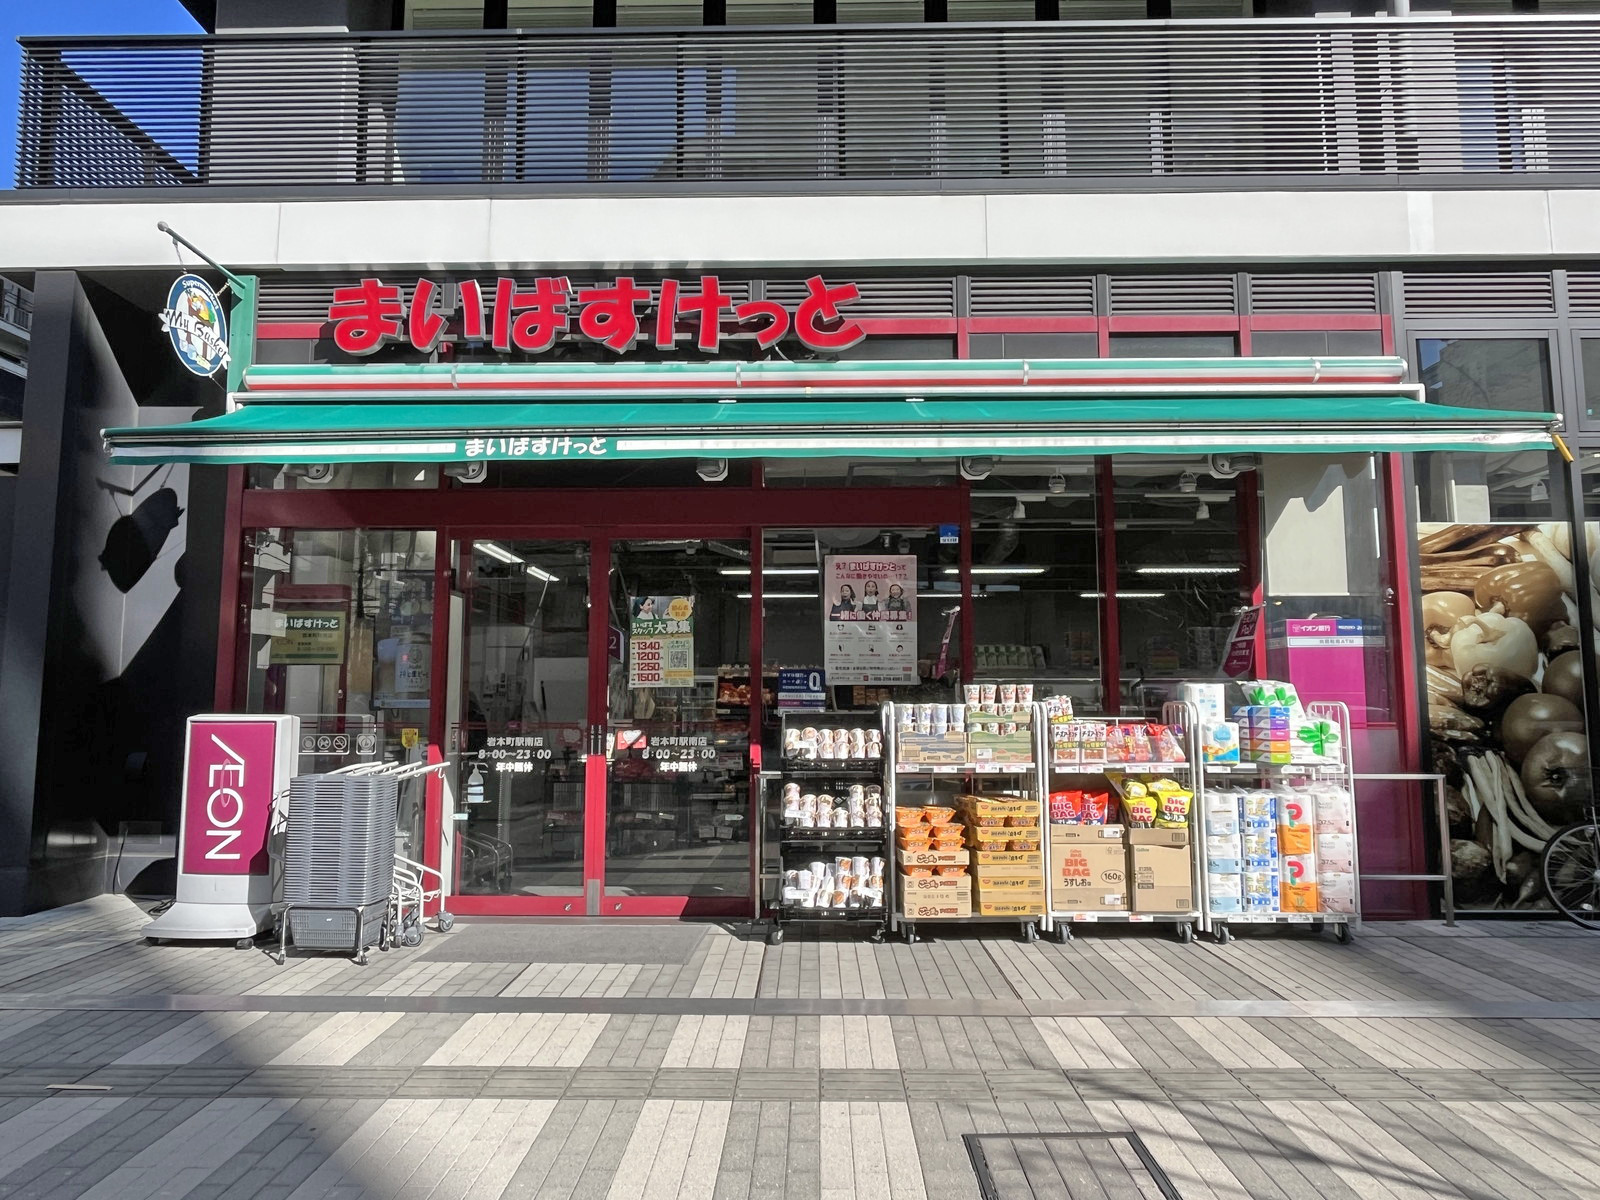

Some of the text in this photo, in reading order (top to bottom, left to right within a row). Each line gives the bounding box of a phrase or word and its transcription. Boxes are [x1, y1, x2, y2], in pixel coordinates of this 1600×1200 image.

[181, 280, 220, 310] Supermarket
[328, 275, 867, 356] まいばすけっと
[165, 310, 228, 358] My Basket
[464, 436, 608, 457] まいばすけっと
[654, 620, 691, 634] 大募集
[486, 736, 544, 747] 岩本町駅南店
[650, 736, 708, 747] 岩本町駅南店
[495, 761, 534, 773] 年中無休
[659, 761, 698, 773] 年中無休
[204, 733, 245, 860] AEON
[1166, 797, 1185, 806] BIG
[1052, 802, 1072, 810] BIG
[1132, 806, 1151, 814] BIG
[1164, 804, 1186, 814] BAG
[1051, 810, 1075, 819] BAG
[1131, 814, 1153, 823] BAG
[1064, 858, 1088, 867] BIG
[1062, 868, 1091, 877] BAG
[1104, 872, 1122, 881] 160g
